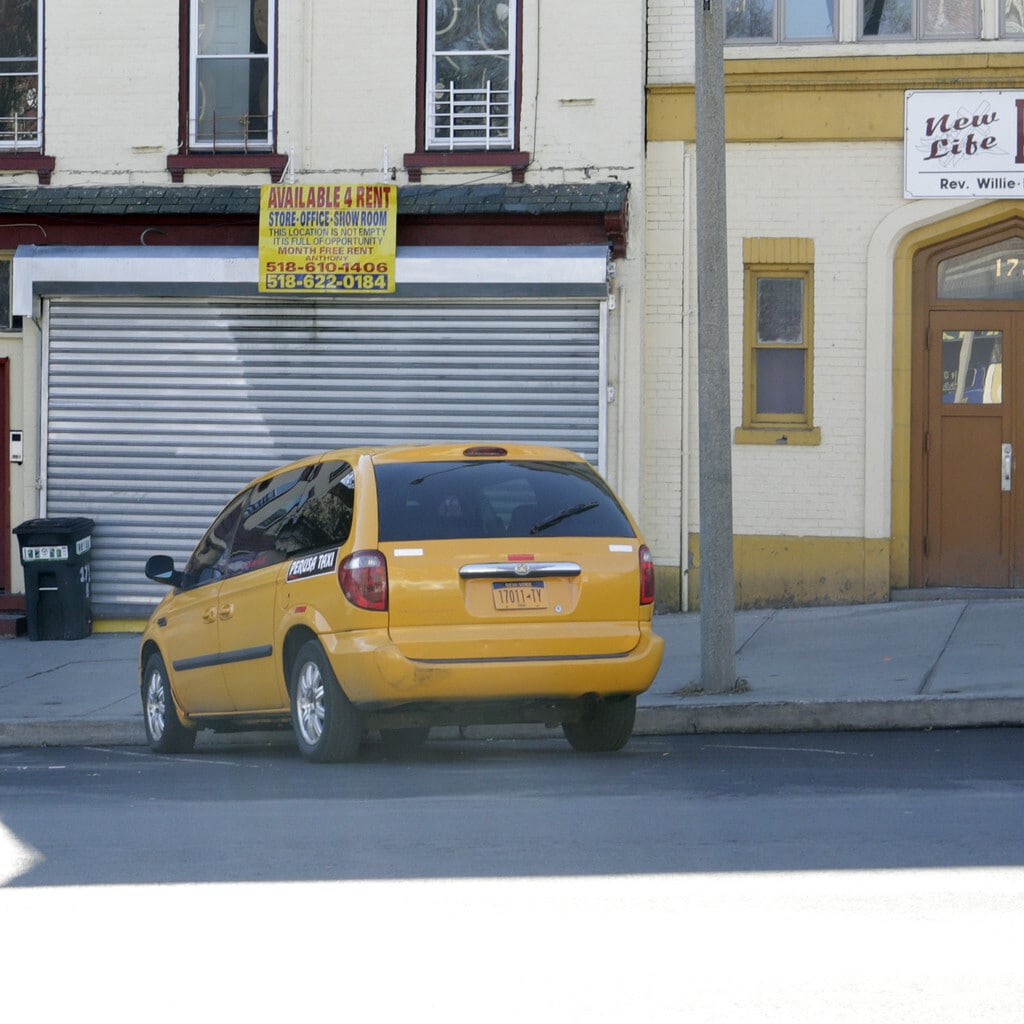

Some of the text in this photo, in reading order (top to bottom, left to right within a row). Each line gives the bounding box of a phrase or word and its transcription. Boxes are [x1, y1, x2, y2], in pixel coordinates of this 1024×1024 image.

[926, 112, 1000, 137] New
[923, 134, 998, 161] Life
[940, 178, 1016, 190] Rev. Willie
[268, 186, 391, 209] AVAILABLE 4 RENT
[361, 211, 387, 226] ROOM
[269, 228, 387, 236] THIS LOCATION IS NOT EMPTY
[273, 237, 383, 245] IT IS FULL OF OPPORTUNITY
[278, 247, 374, 255] MONTH FREE RENT
[266, 262, 388, 273] 518-610-1406
[995, 258, 1024, 277] 17
[267, 275, 386, 289] 518-622-0184
[317, 551, 336, 570] TAXI
